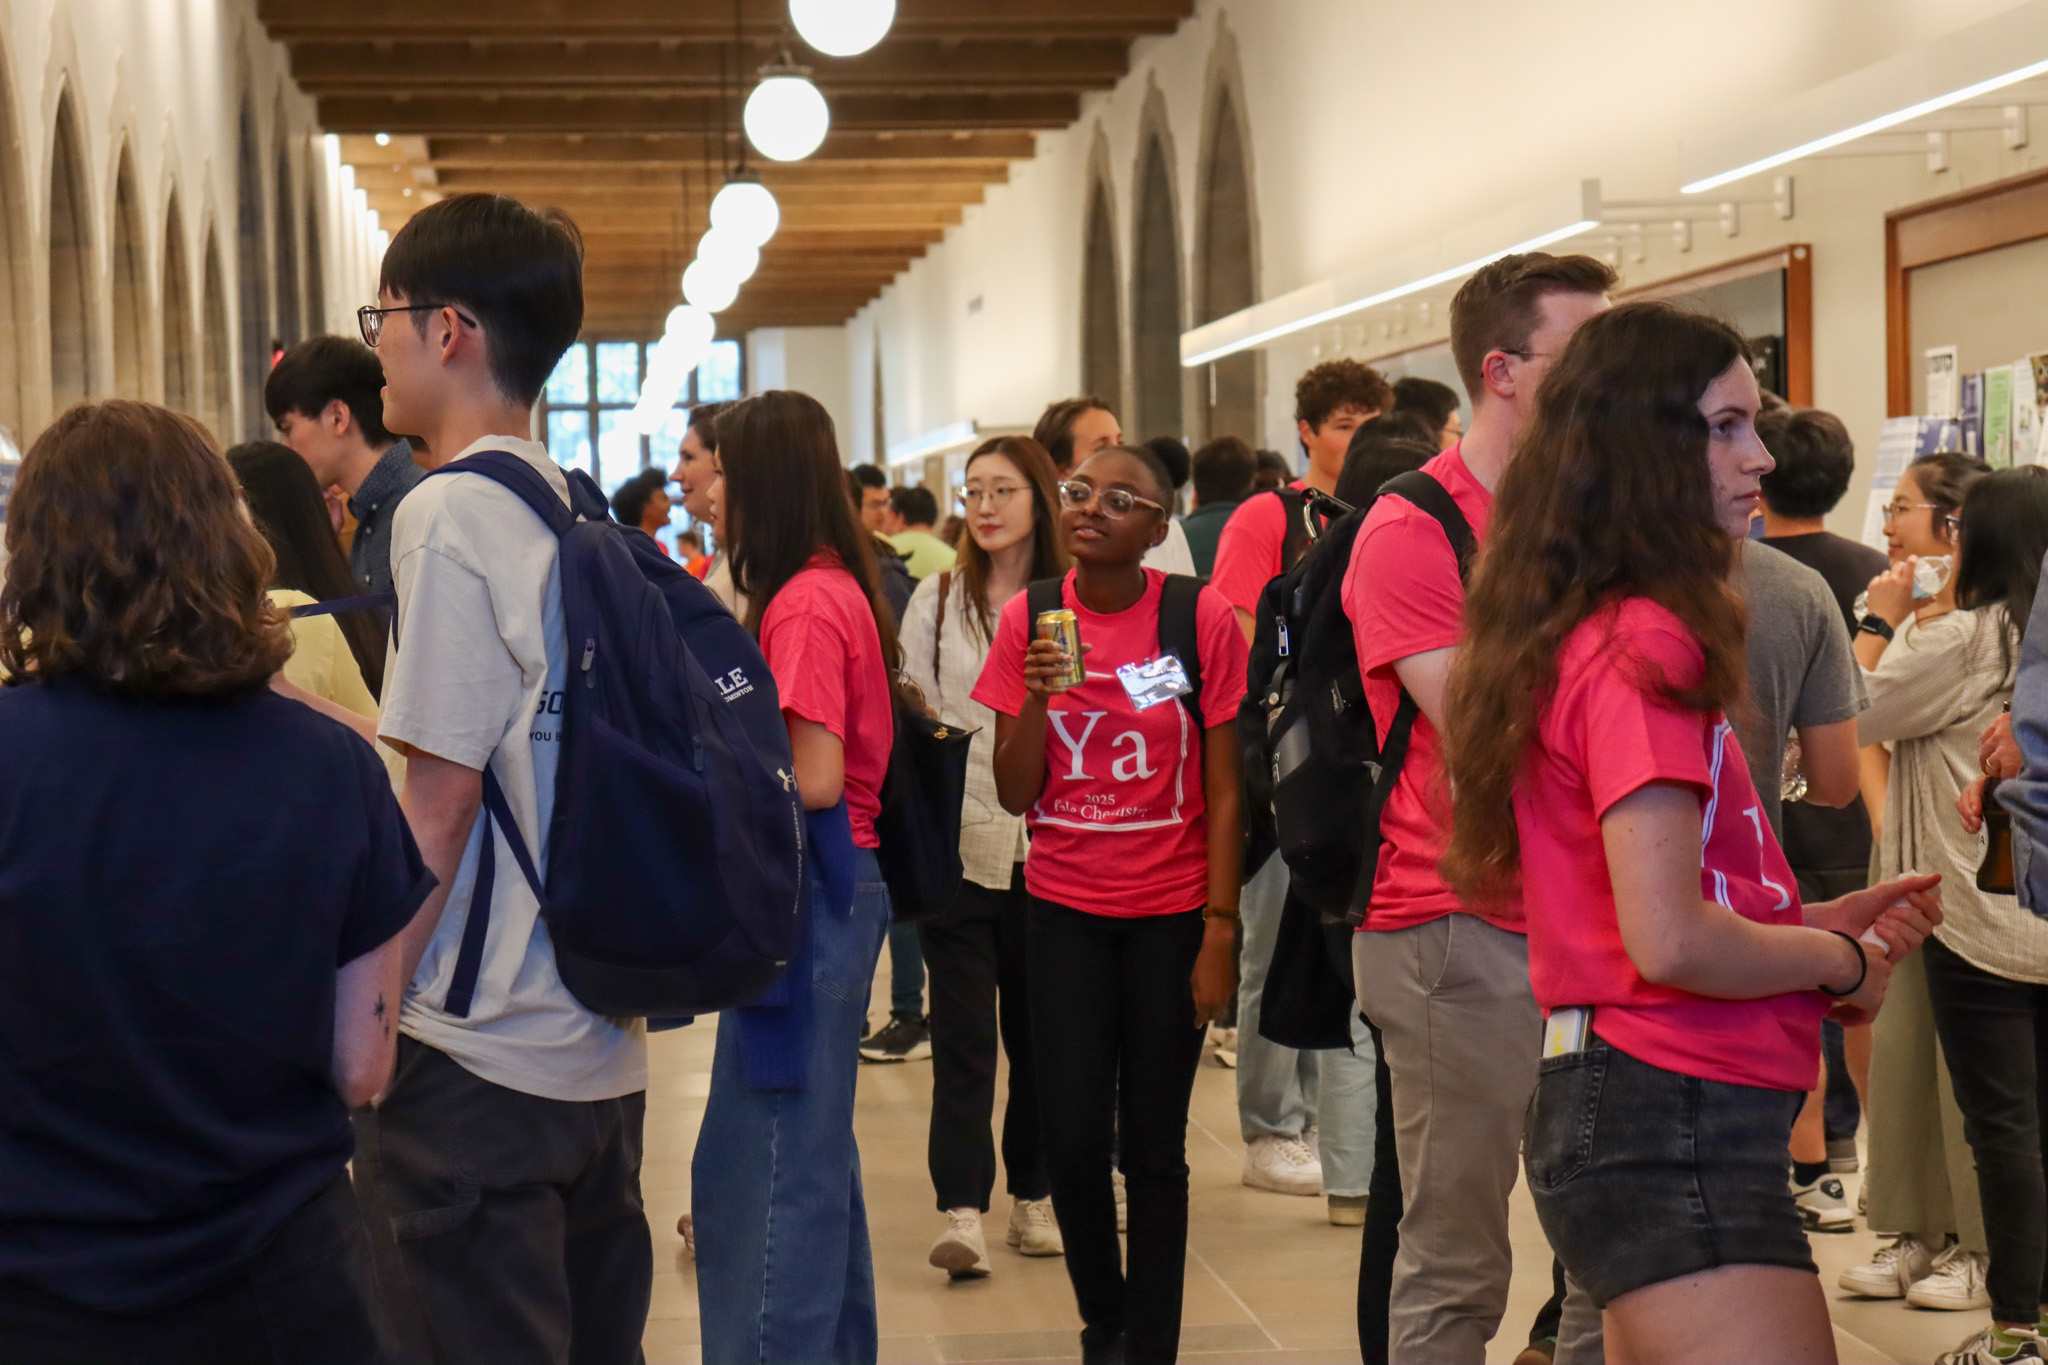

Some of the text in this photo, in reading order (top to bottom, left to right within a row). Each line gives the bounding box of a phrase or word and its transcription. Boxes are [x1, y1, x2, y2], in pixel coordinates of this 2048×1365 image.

[714, 667, 749, 695] LE
[529, 731, 552, 742] YOU
[1047, 709, 1158, 782] Ya
[1085, 794, 1116, 805] 2025
